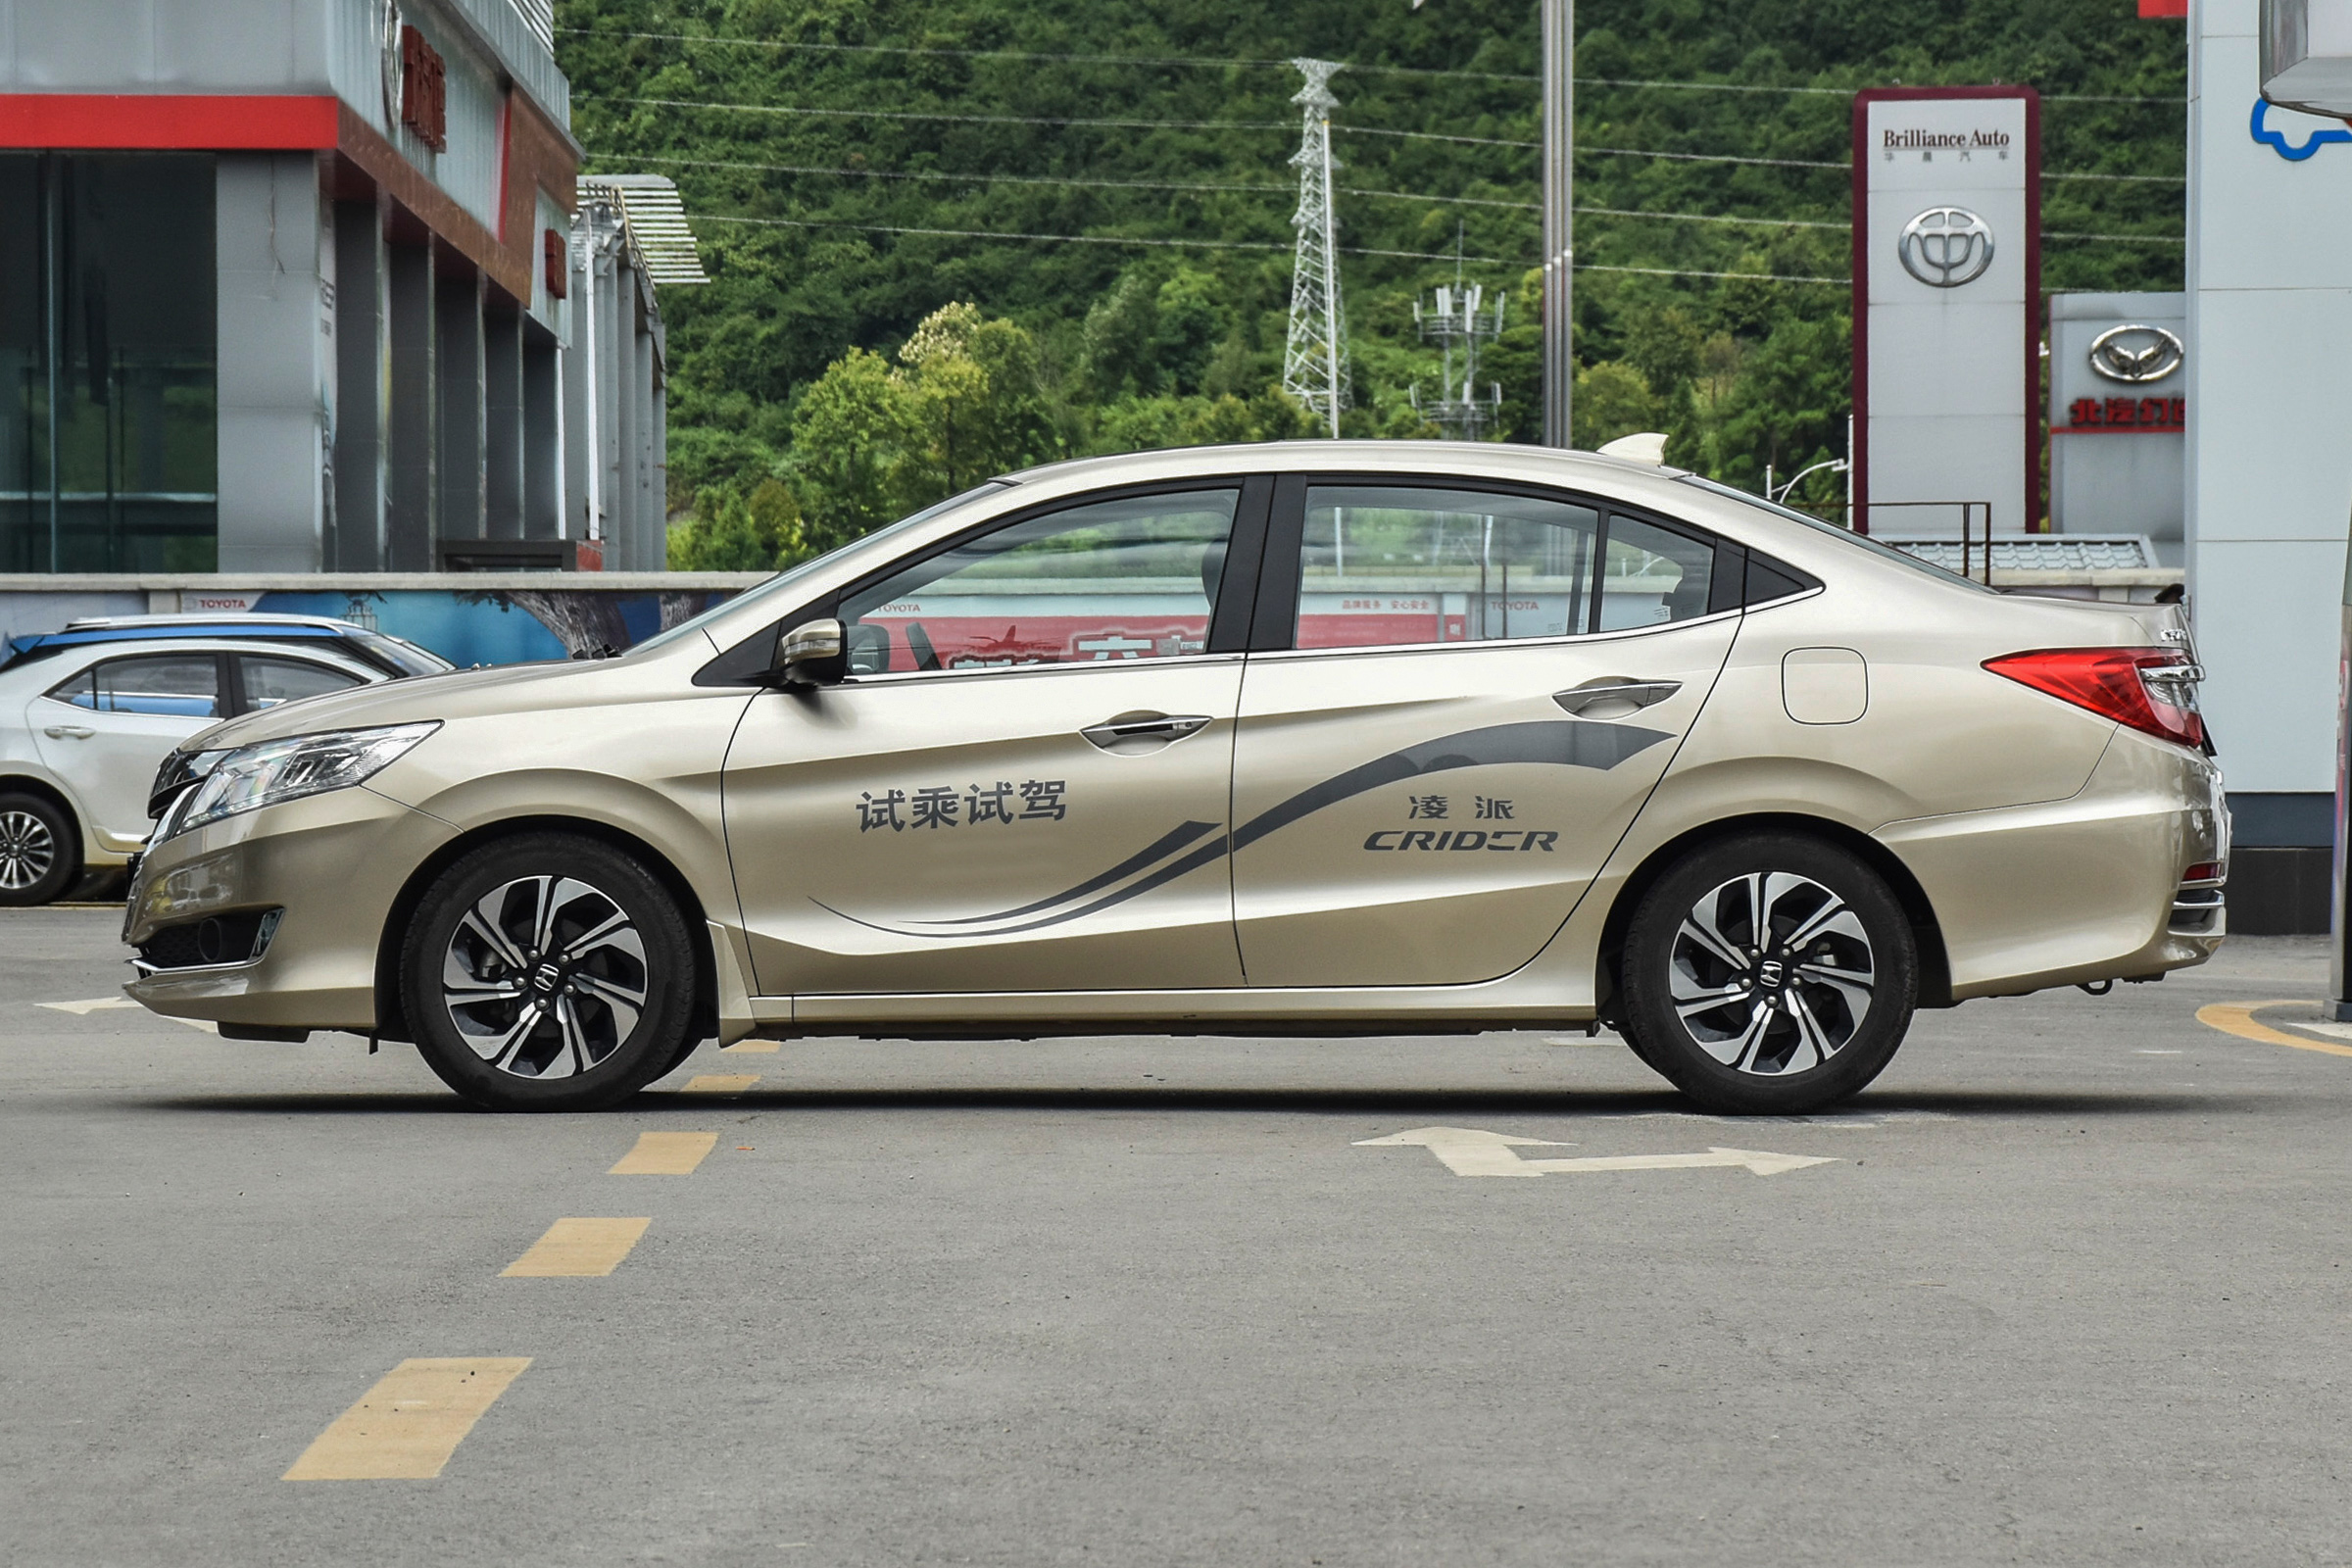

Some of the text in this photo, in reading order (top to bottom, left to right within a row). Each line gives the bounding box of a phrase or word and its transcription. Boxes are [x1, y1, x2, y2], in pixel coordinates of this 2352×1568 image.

[1884, 128, 2010, 147] Brilliance Auto
[199, 599, 246, 608] TOYOTA
[1491, 601, 1540, 611] TOYOTA
[856, 779, 1066, 833] 试乘试驾
[1408, 795, 1515, 819] 凌派
[1363, 830, 1558, 852] CRIDER
